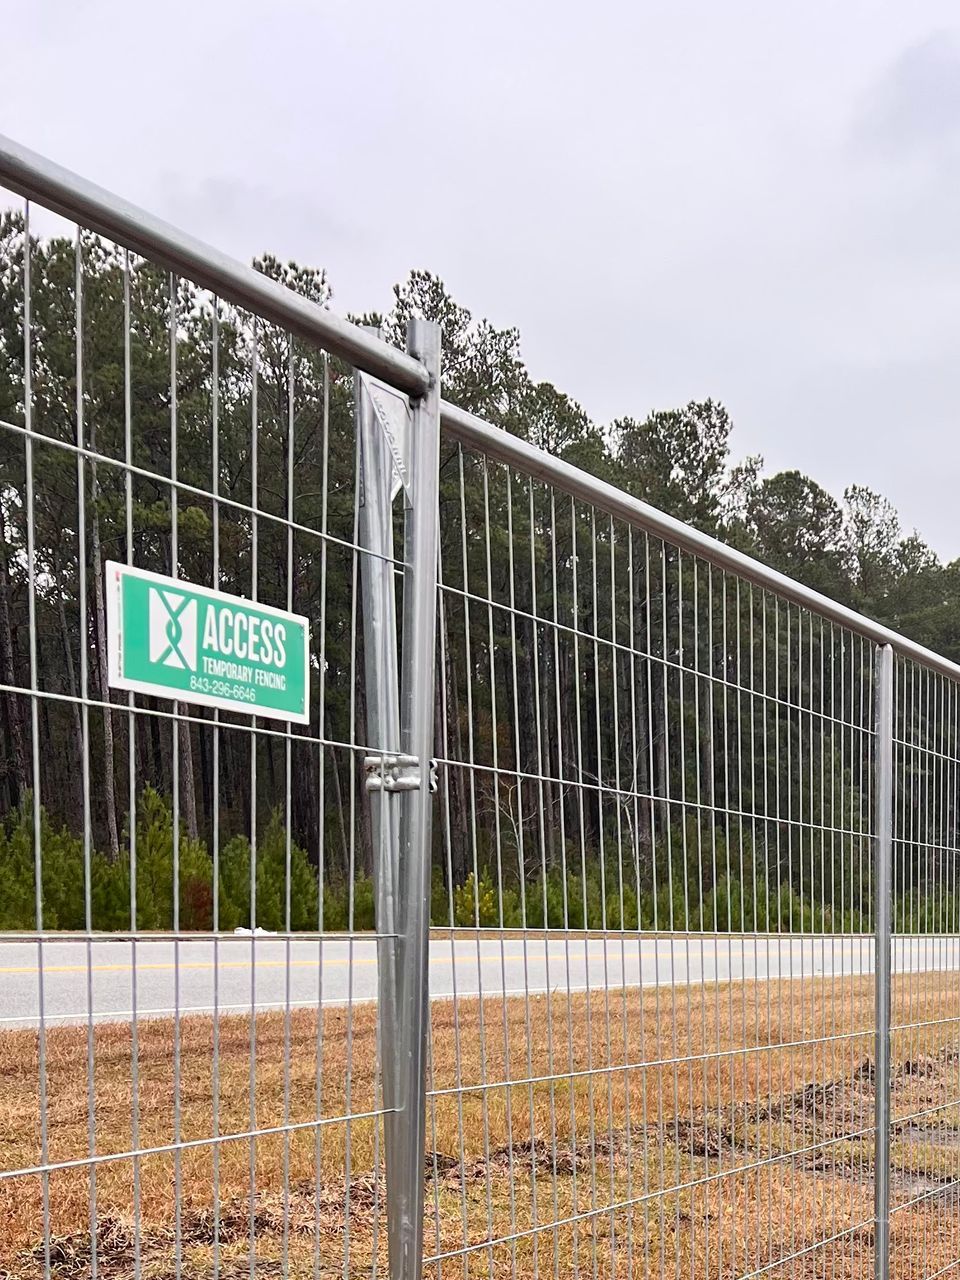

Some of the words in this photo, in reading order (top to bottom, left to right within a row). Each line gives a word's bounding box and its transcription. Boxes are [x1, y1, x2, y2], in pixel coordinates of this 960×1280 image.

[202, 604, 286, 668] ACCESS
[190, 675, 256, 702] 843-296-6646
[202, 656, 253, 684] TEMPORARY
[255, 668, 286, 691] FENCING
